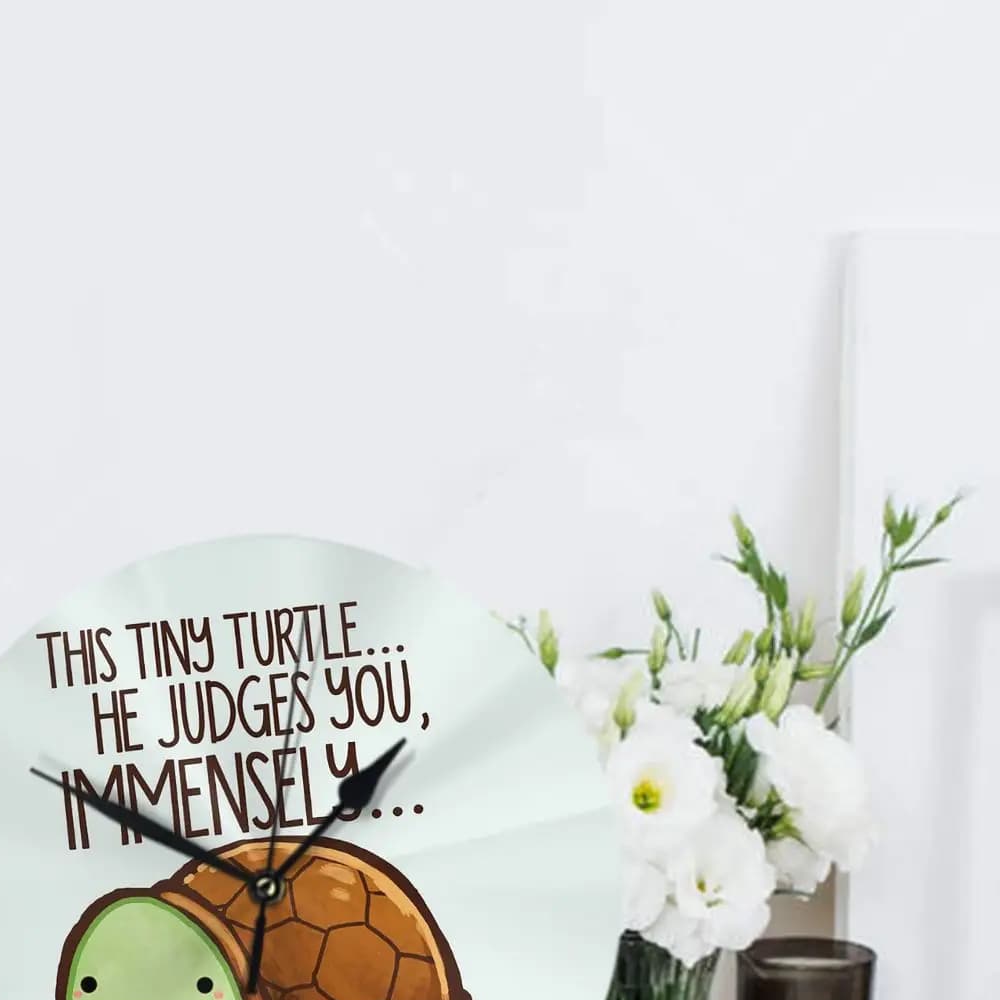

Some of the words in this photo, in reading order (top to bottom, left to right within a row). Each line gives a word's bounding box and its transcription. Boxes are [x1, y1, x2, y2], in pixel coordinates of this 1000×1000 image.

[36, 627, 117, 688] THIS
[125, 616, 215, 680] TINY
[223, 601, 405, 669] TURTLE...
[92, 688, 143, 755] HE
[158, 671, 315, 748] JUDGES
[325, 660, 430, 731] YOU,
